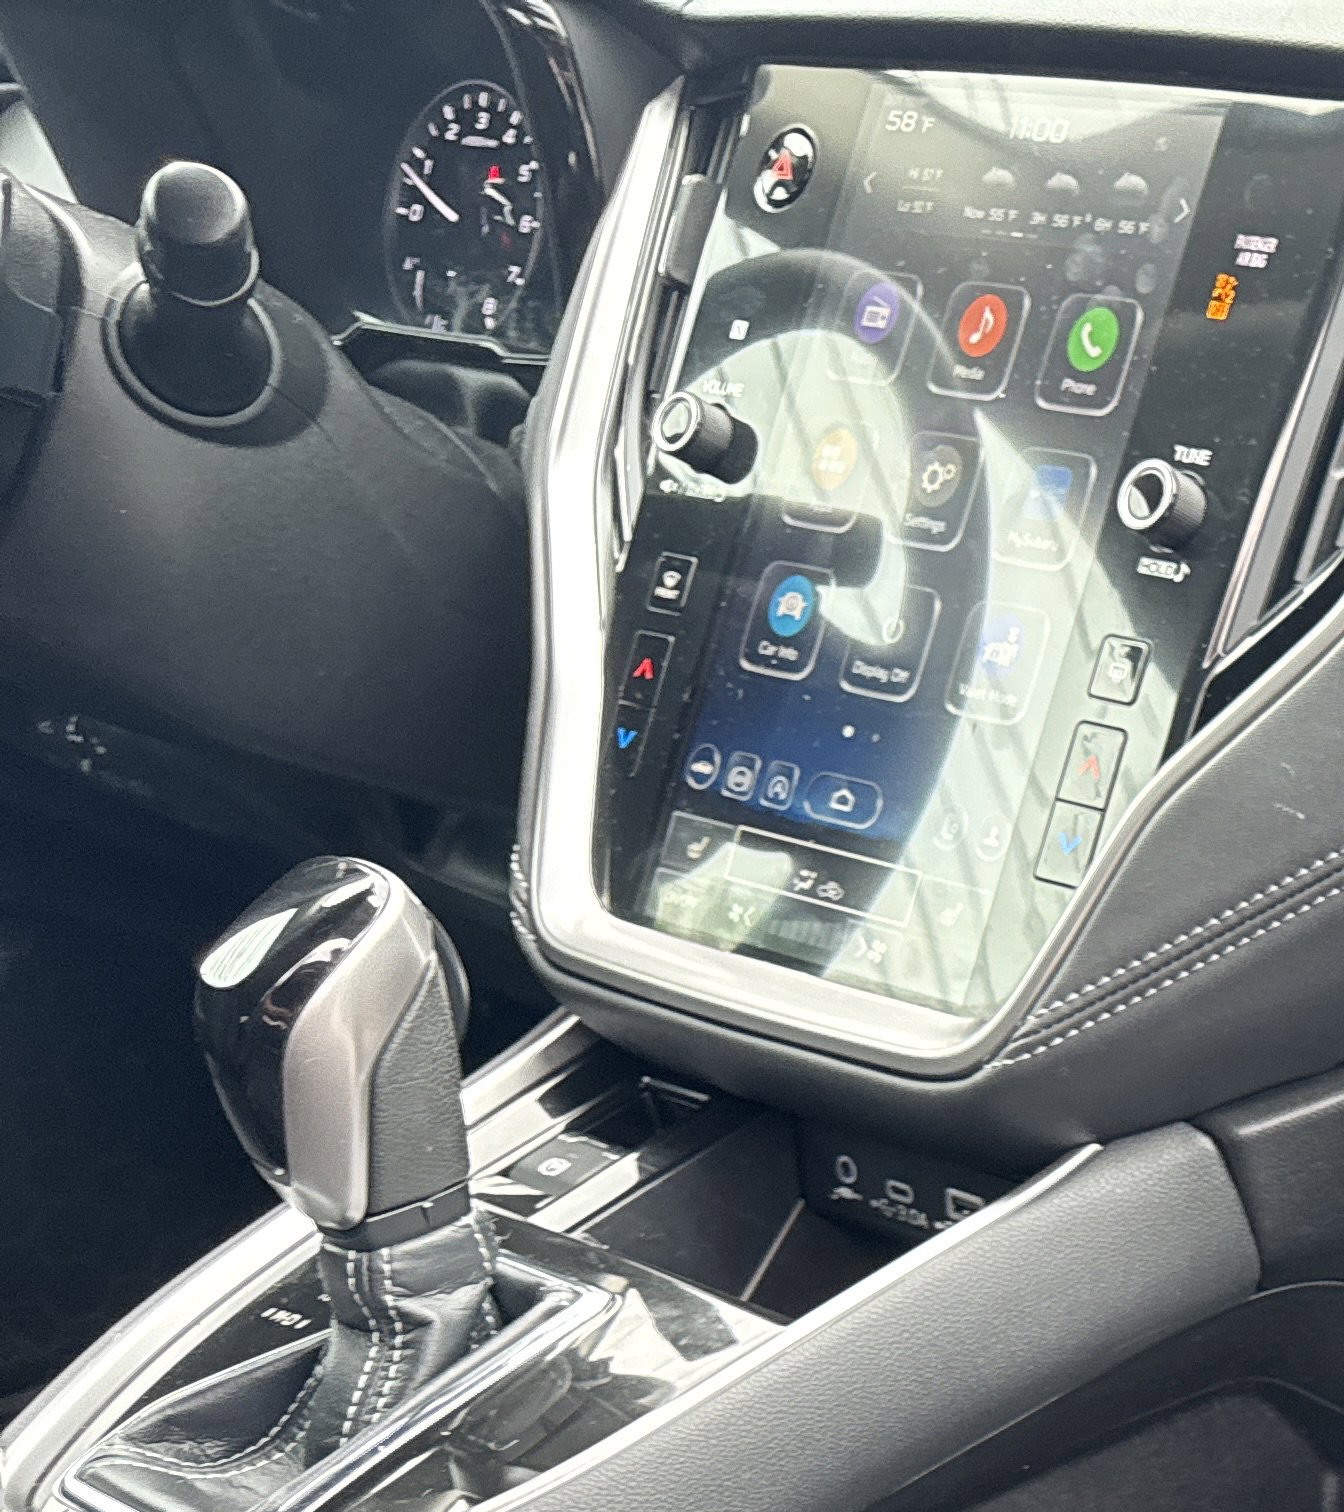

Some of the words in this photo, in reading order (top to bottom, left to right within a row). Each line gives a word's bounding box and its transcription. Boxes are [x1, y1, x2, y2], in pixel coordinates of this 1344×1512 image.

[474, 111, 491, 130] 3
[1009, 115, 1071, 144] 11:00
[444, 122, 461, 141] 2
[502, 127, 518, 144] 4
[516, 163, 532, 183] 5
[702, 374, 745, 397] VOLUME
[1174, 444, 1213, 466] TUNE
